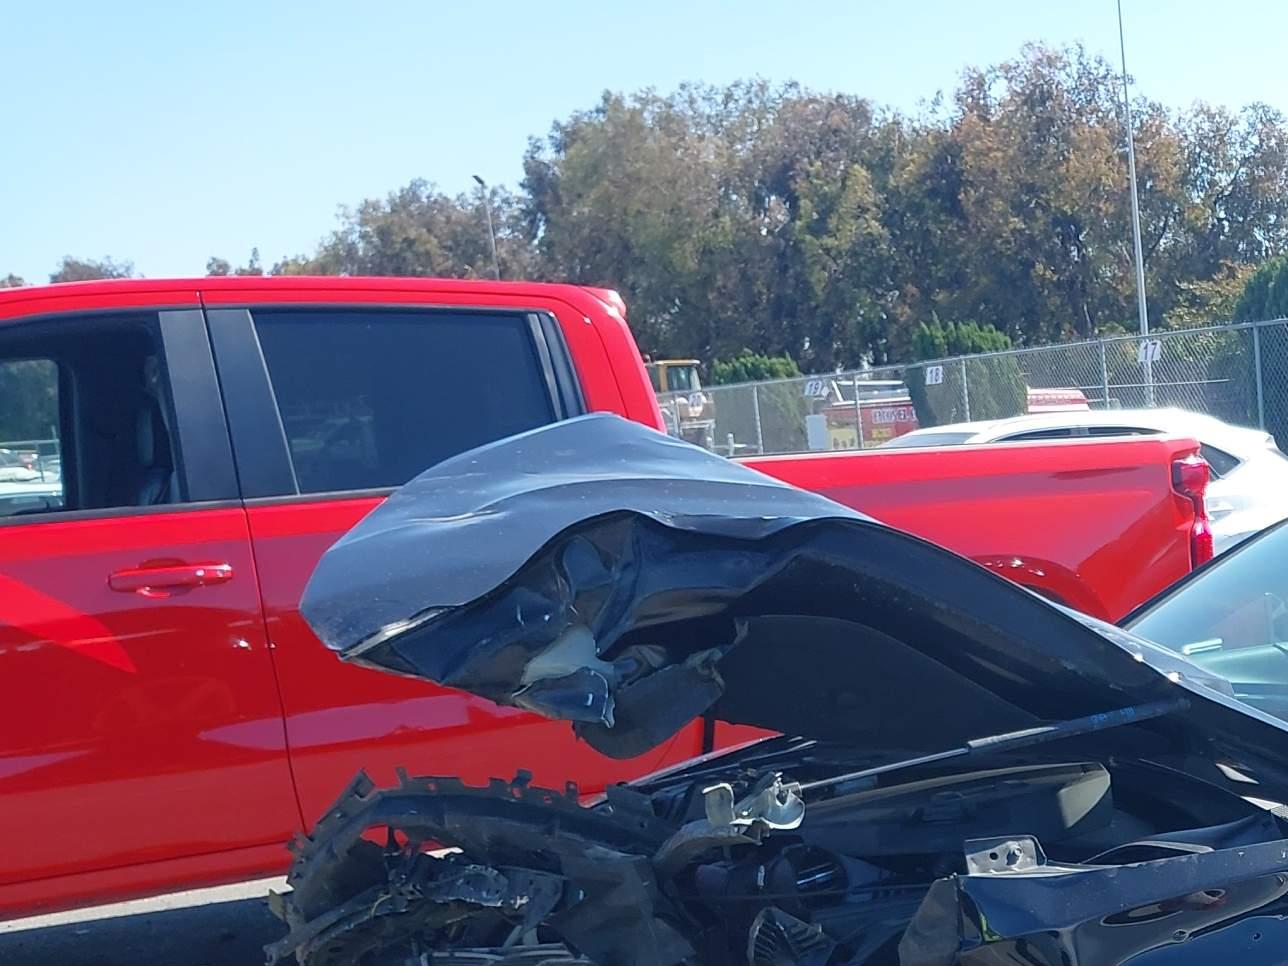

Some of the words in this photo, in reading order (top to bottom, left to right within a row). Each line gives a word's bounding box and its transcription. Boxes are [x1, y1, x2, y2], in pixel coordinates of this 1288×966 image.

[1143, 342, 1158, 360] 17
[929, 367, 940, 383] 18
[807, 381, 821, 395] 19
